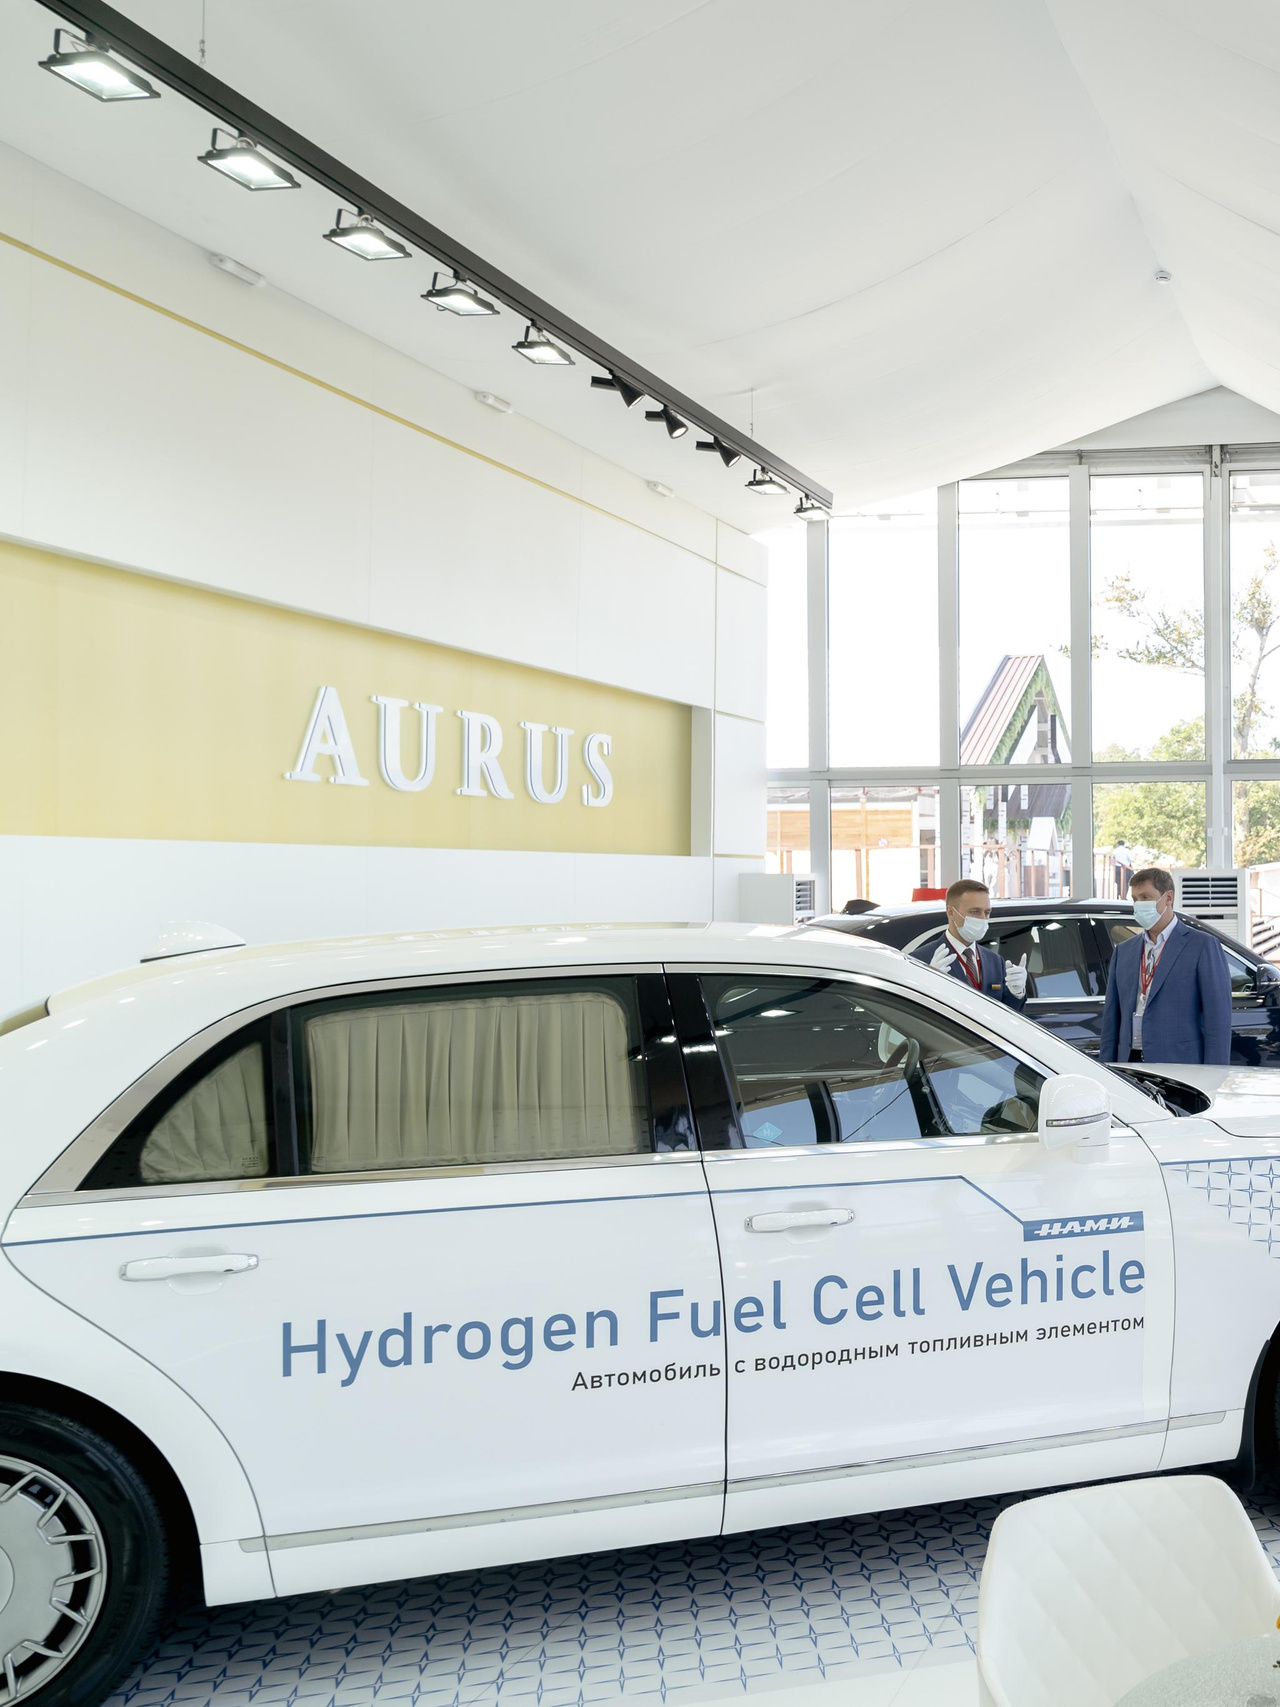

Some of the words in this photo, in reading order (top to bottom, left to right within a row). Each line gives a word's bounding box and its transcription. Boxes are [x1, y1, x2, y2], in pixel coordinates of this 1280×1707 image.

[283, 685, 615, 808] AURUS
[1034, 1217, 1135, 1237] НАМИ
[283, 1311, 618, 1387] Hydrogen
[650, 1280, 786, 1342] Fuel
[814, 1268, 925, 1325] Cell
[948, 1250, 1145, 1310] Vehicle
[572, 1362, 721, 1391] Автомобиль
[734, 1358, 747, 1375] с
[755, 1342, 899, 1372] водородным
[908, 1328, 1029, 1356] топливным
[1035, 1316, 1145, 1342] элементом
